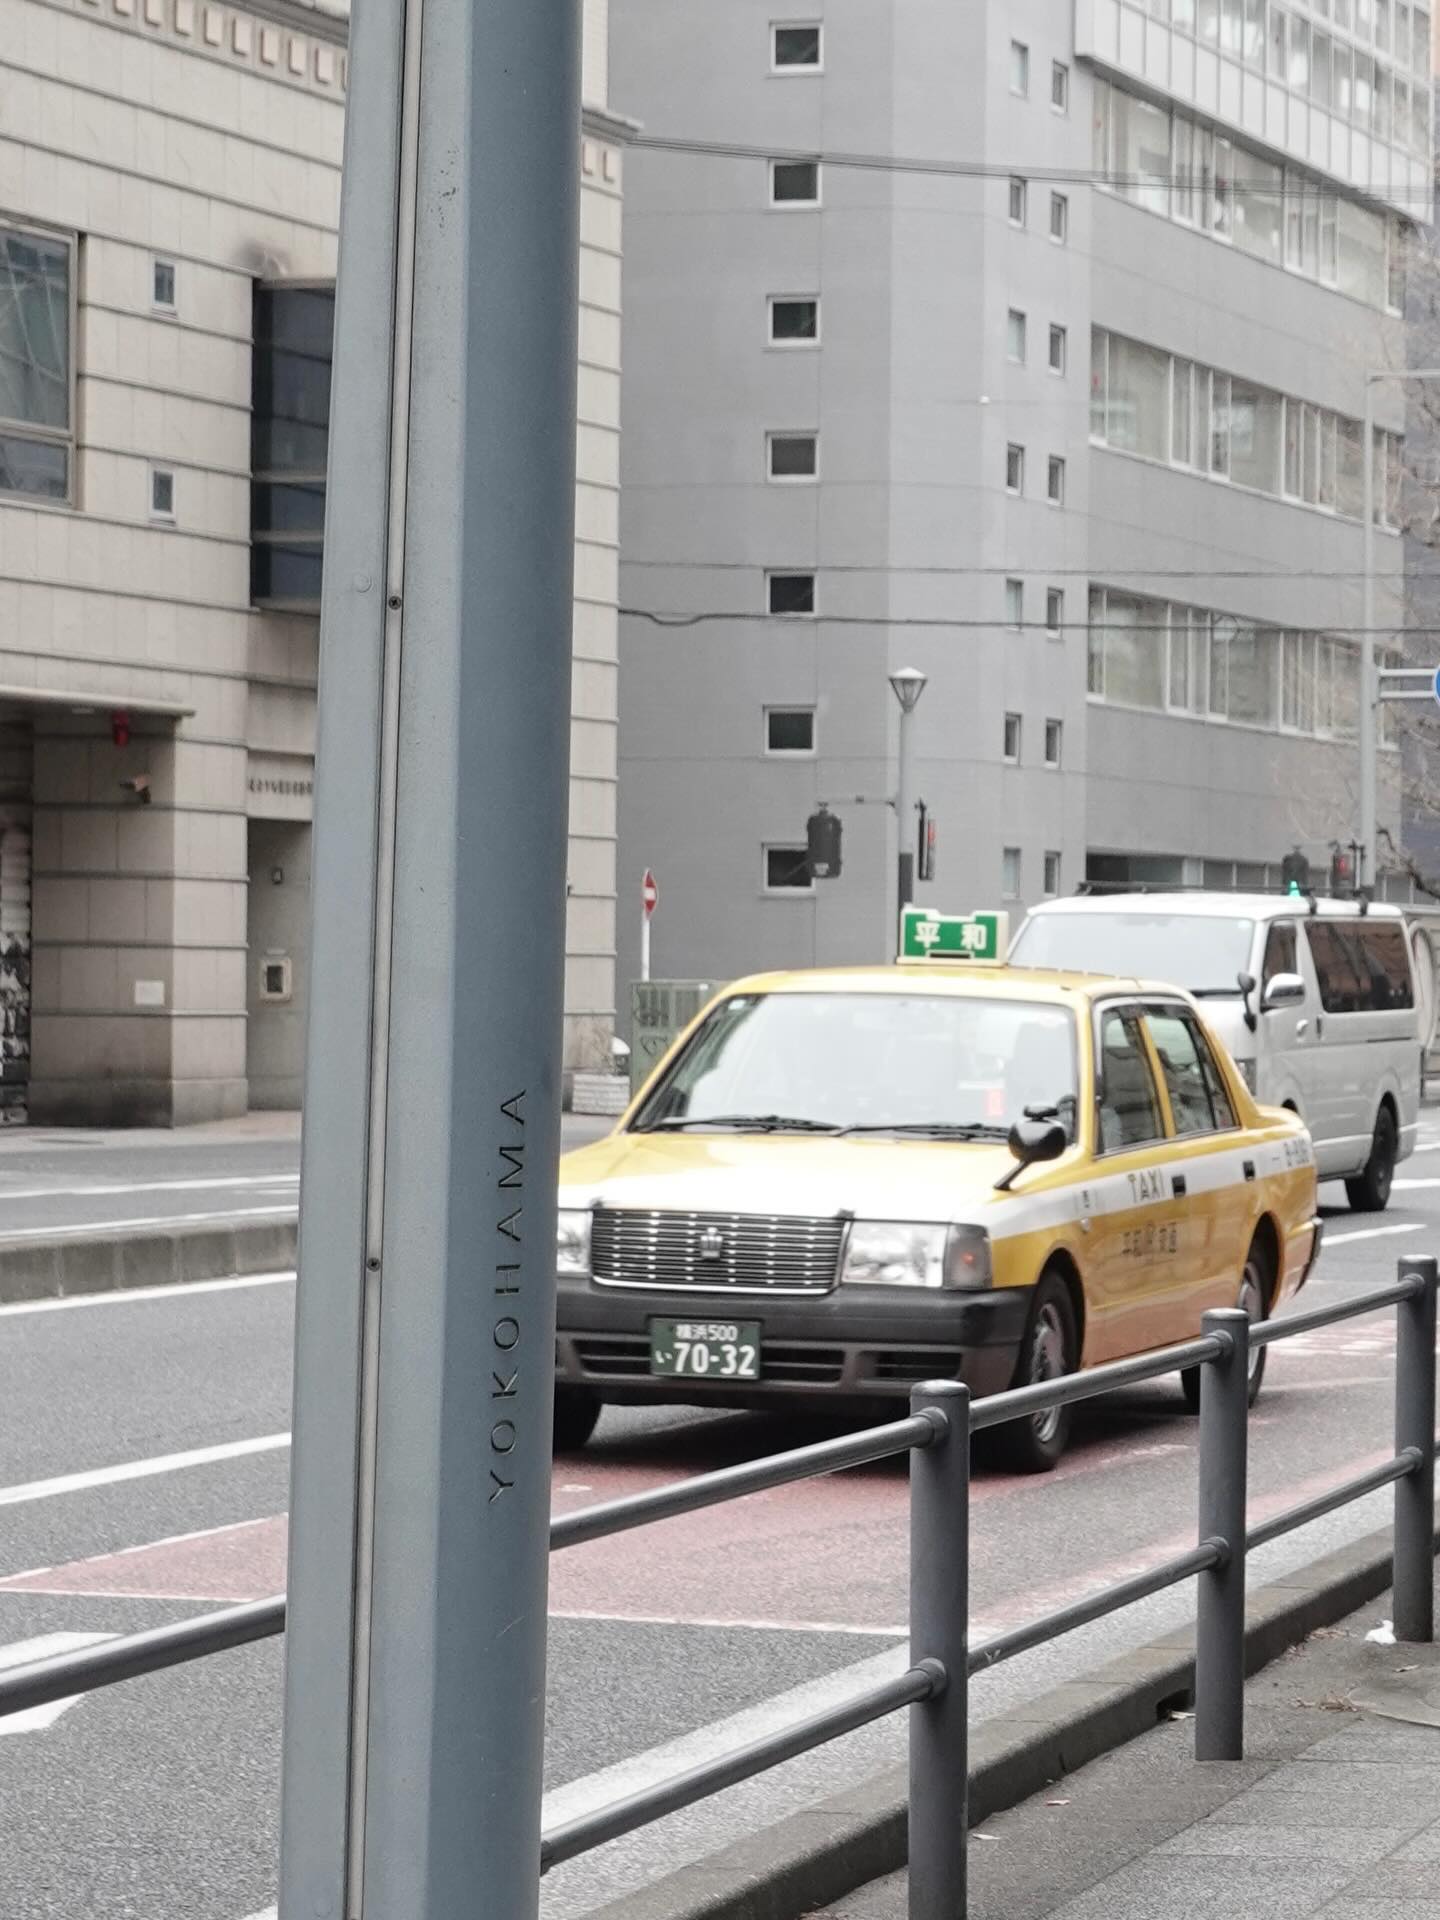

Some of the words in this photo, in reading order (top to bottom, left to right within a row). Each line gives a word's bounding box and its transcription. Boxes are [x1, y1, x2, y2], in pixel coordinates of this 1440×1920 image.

[914, 922, 987, 950] 平和
[1127, 1168, 1165, 1203] TAXI
[488, 1089, 526, 1503] YOKOHAMA
